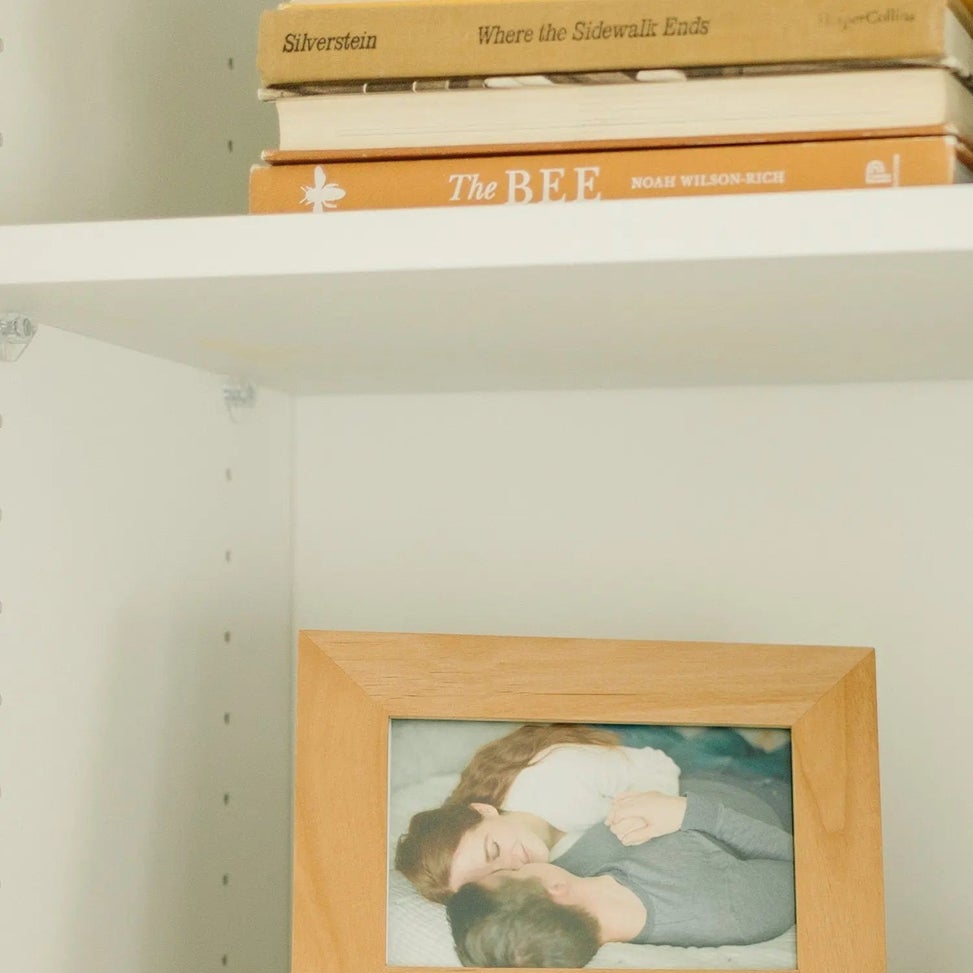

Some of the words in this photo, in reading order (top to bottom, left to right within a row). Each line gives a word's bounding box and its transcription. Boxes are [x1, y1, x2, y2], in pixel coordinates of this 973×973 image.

[283, 32, 377, 53] Silverstein
[478, 26, 534, 45] Where
[538, 24, 567, 42] the
[571, 18, 659, 41] Sidewalk
[662, 16, 711, 36] Ends
[449, 173, 498, 201] The
[504, 165, 603, 205] BEE
[631, 175, 676, 190] NOAH
[680, 170, 785, 188] WILSON-RICH
